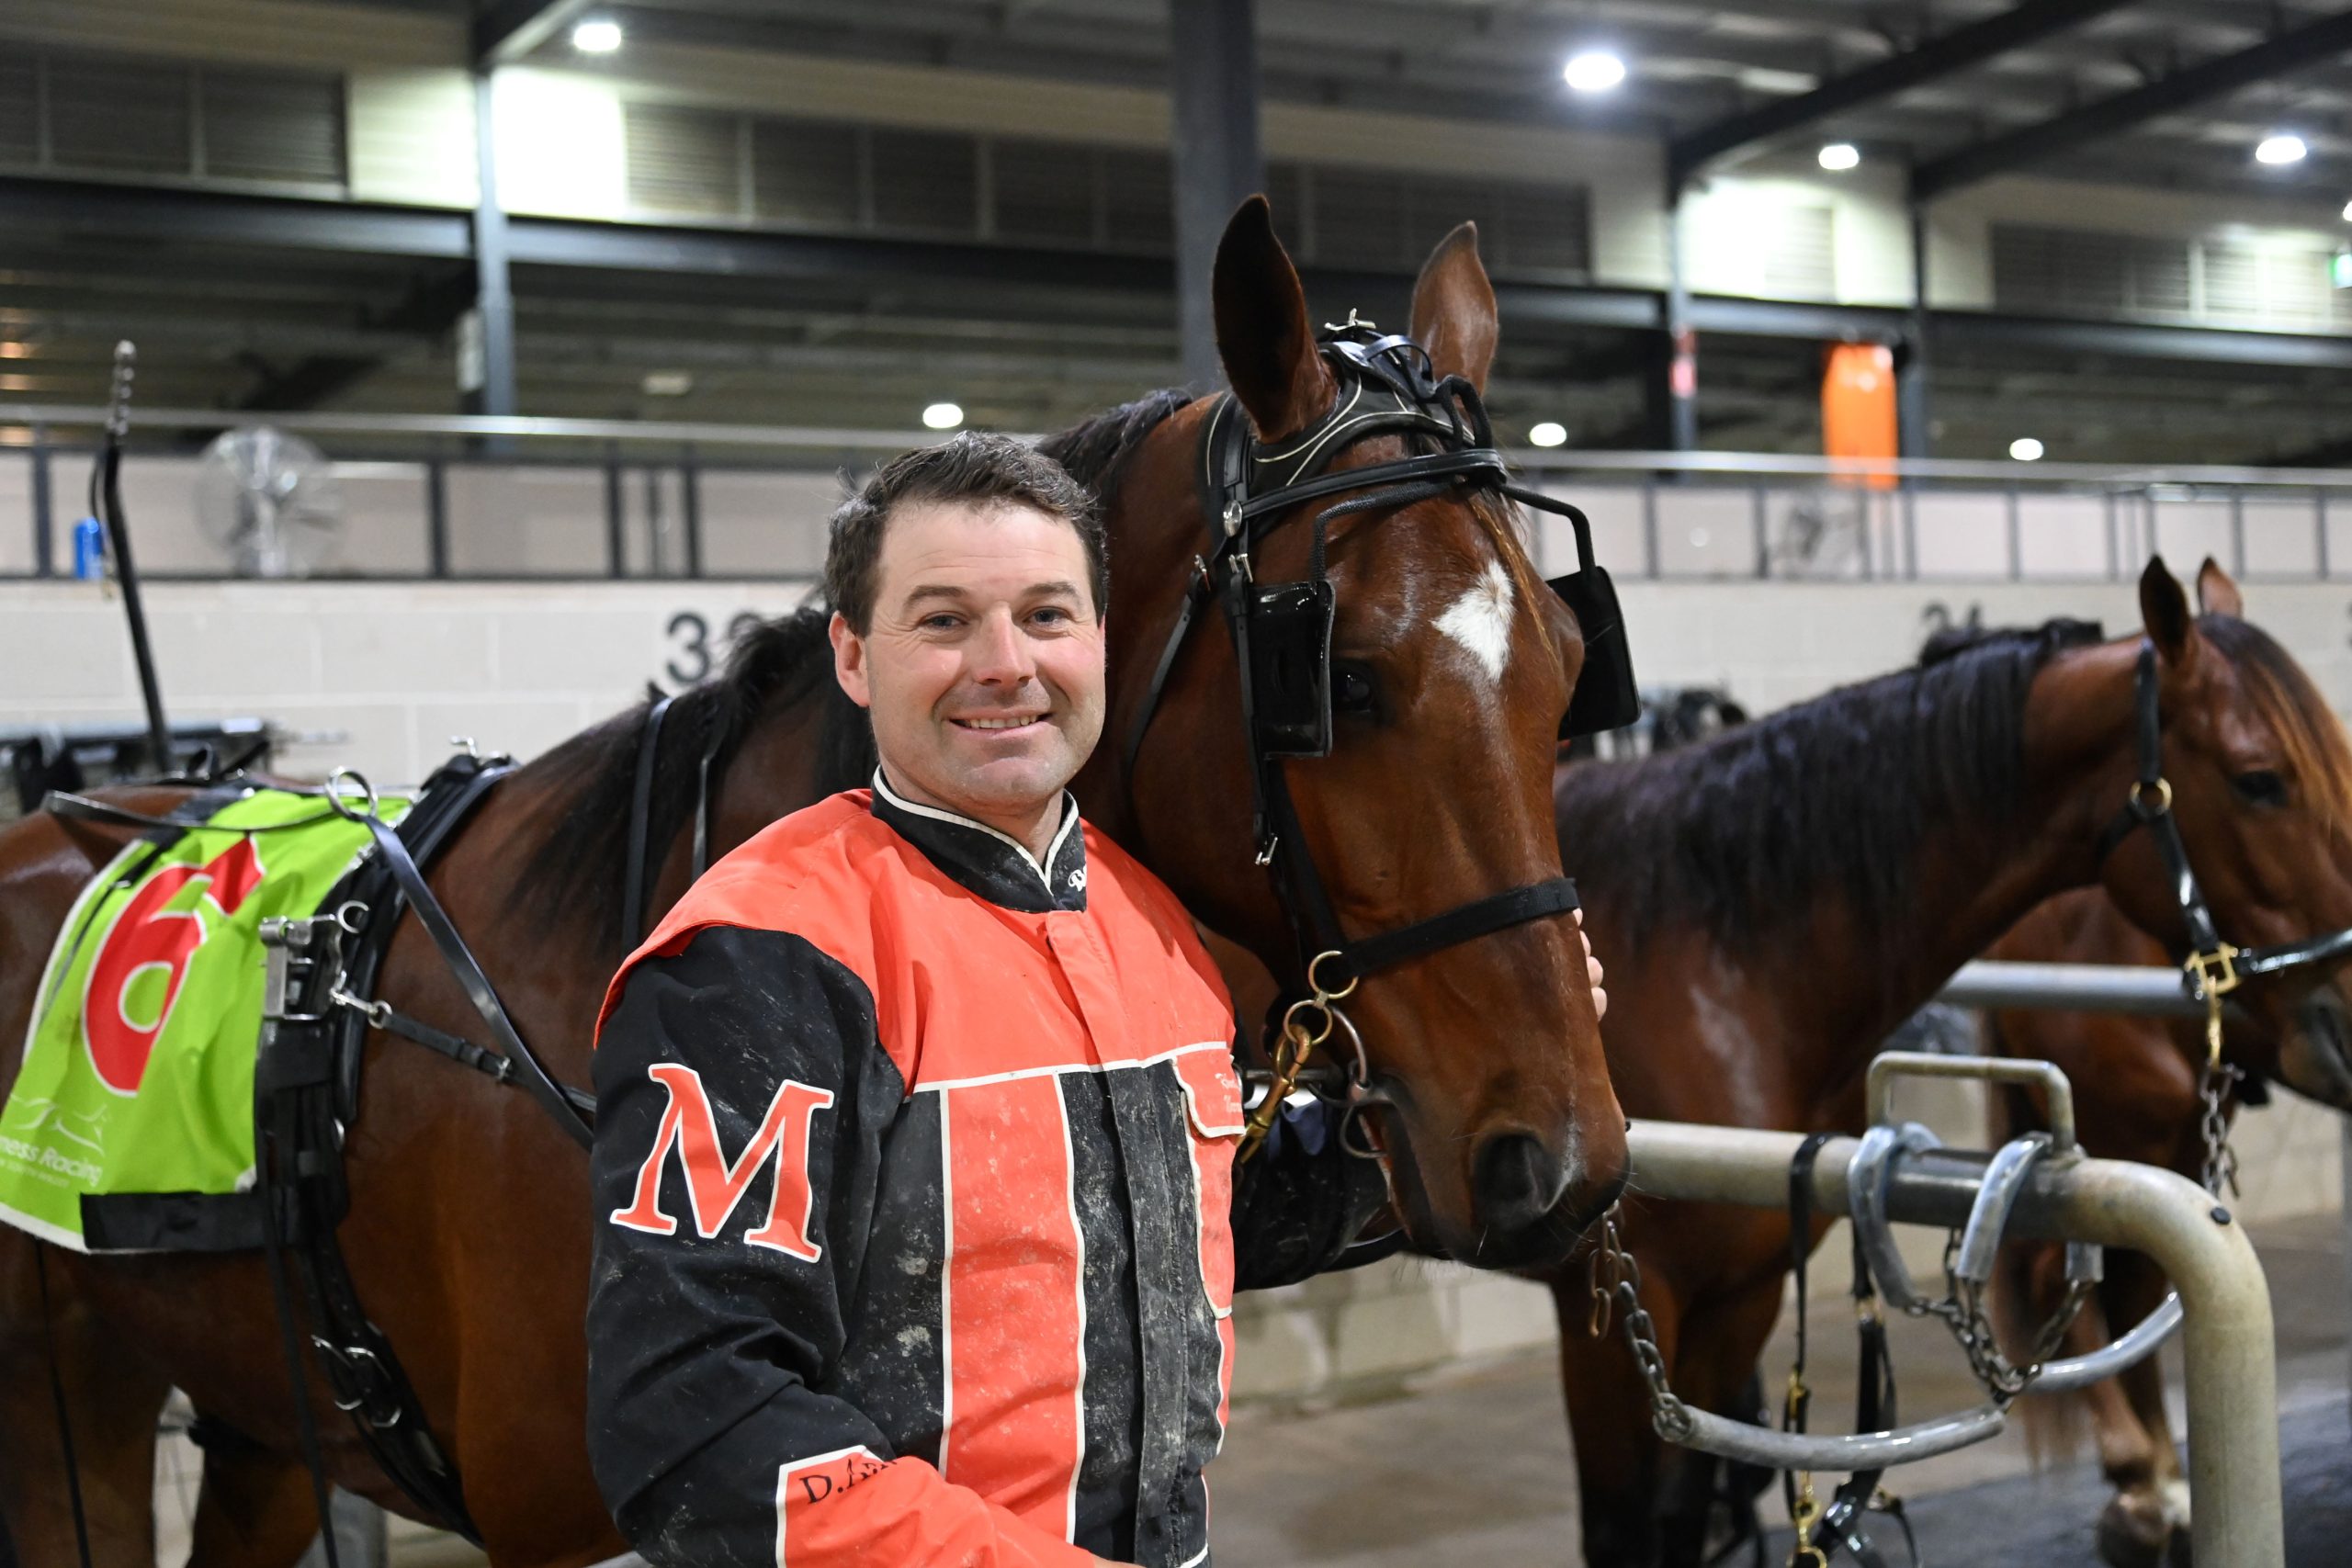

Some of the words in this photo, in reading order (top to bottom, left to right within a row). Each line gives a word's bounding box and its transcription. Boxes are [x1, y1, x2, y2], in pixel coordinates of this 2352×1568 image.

[81, 832, 266, 1097] 6
[40, 1145, 103, 1187] Racing
[610, 1063, 835, 1264] M
